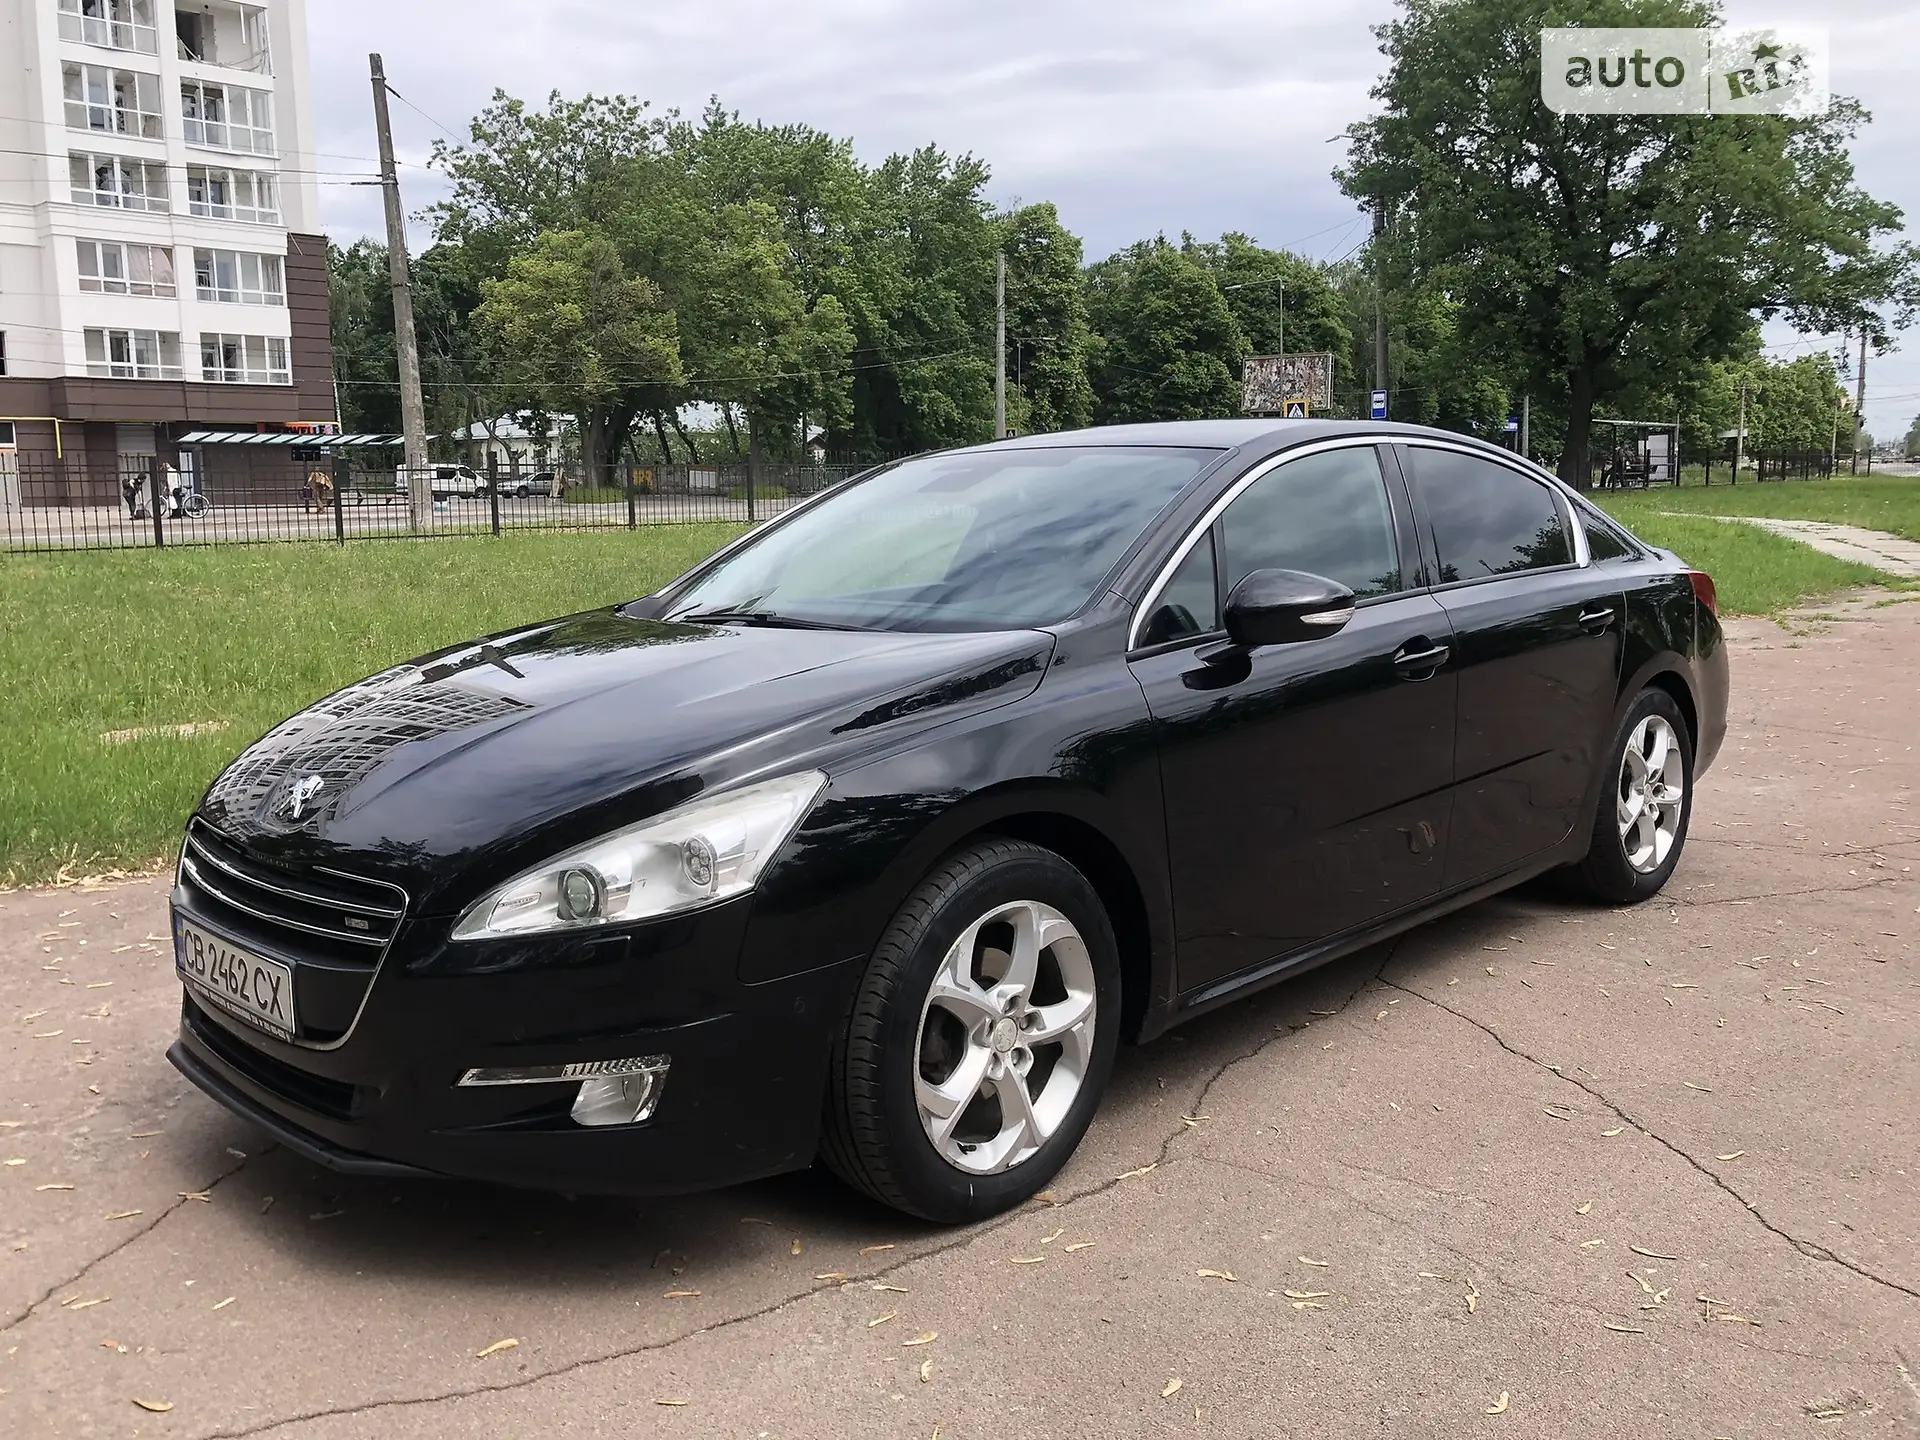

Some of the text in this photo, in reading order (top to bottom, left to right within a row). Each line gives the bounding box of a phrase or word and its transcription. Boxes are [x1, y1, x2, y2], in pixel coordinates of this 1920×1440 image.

[184, 928, 205, 976] CB
[208, 943, 250, 1002] 2462
[254, 967, 284, 1020] CX
